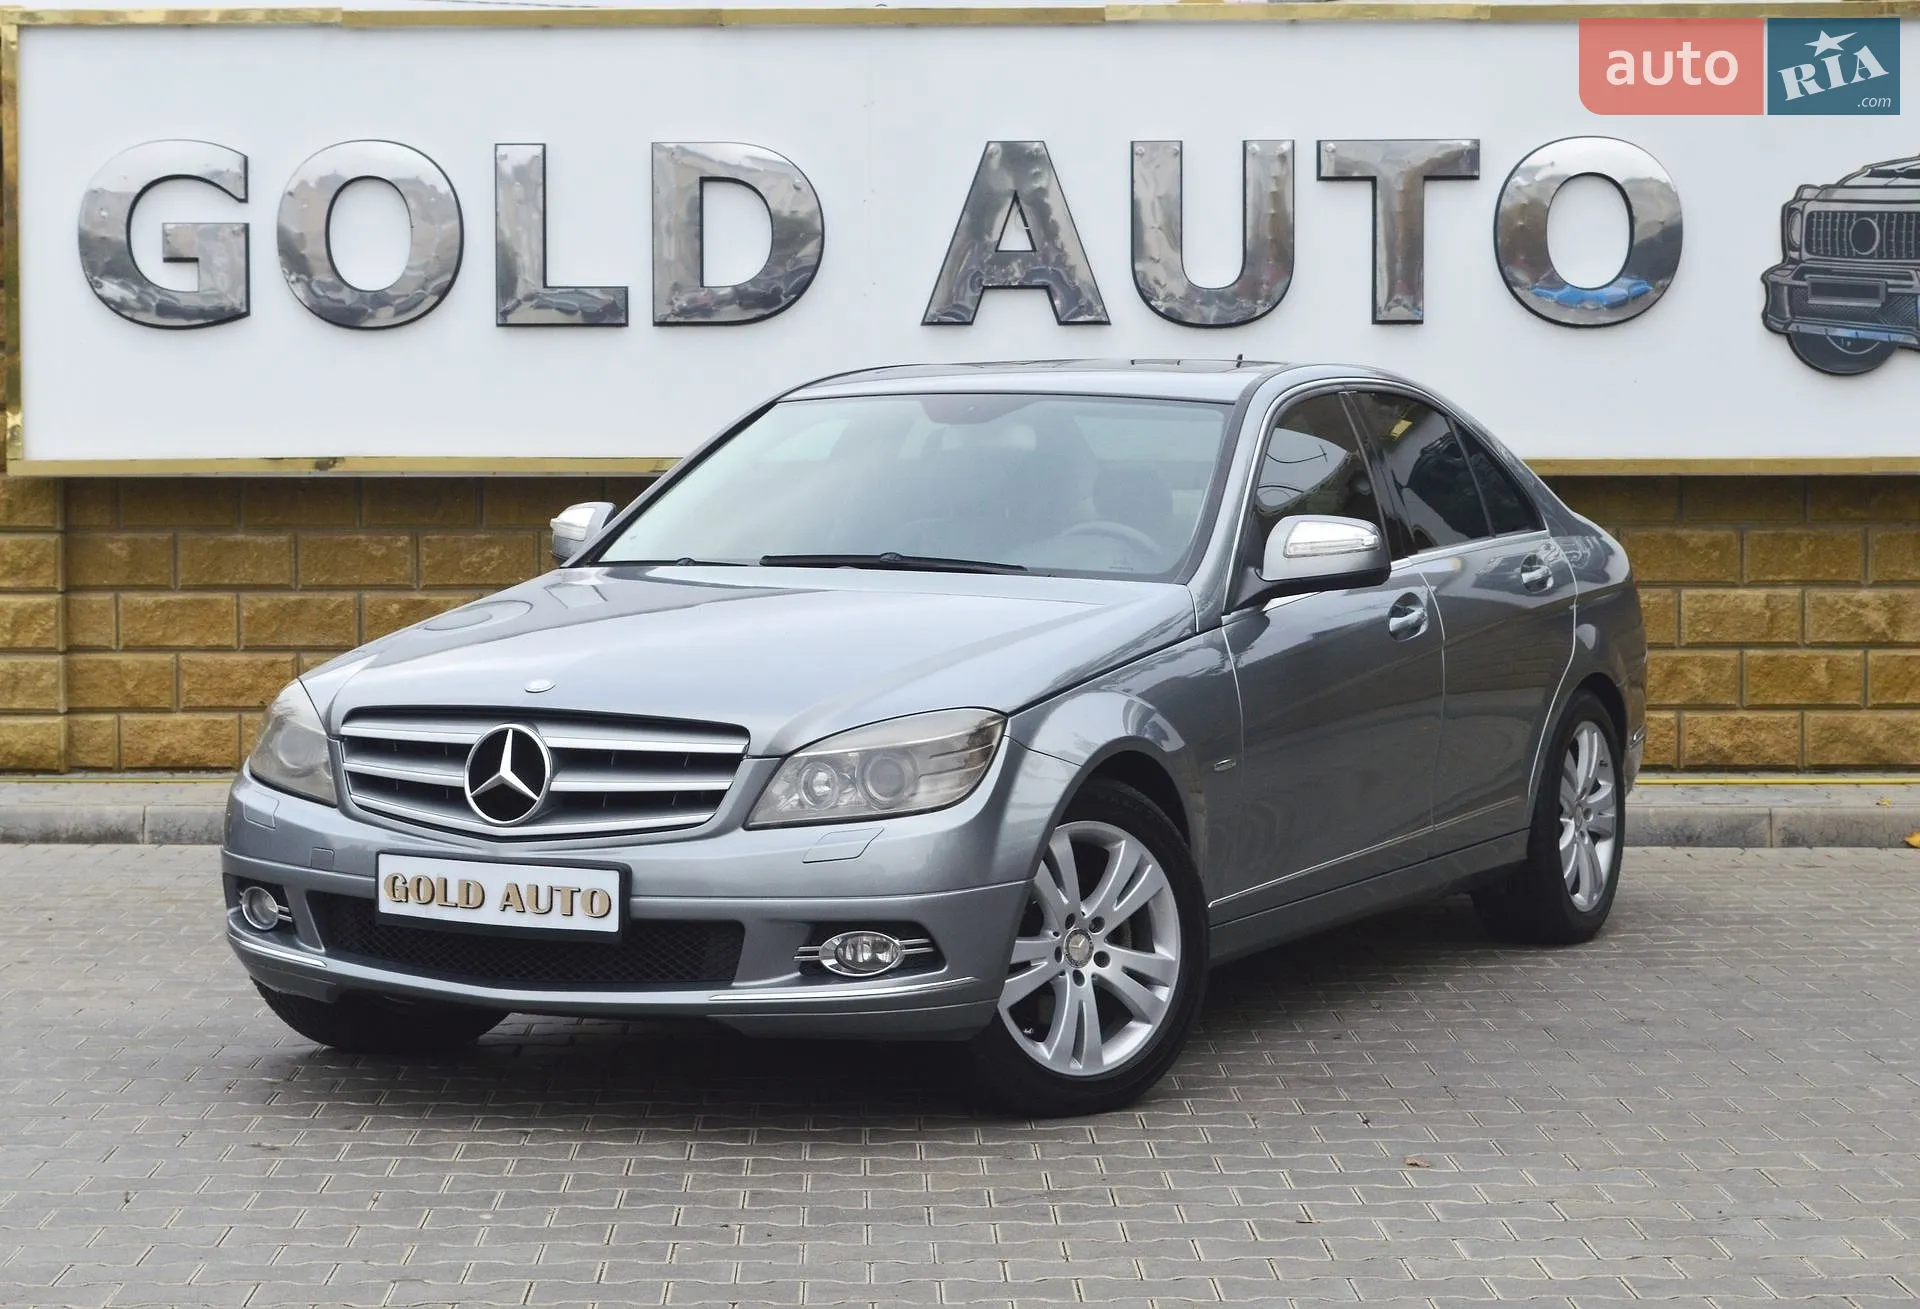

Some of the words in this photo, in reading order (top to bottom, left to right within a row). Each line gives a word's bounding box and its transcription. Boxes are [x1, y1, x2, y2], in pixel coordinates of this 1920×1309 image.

[79, 139, 826, 330] GOLD
[920, 136, 1684, 329] AUTO
[384, 873, 486, 909] GOLD
[499, 883, 612, 918] AUTO
